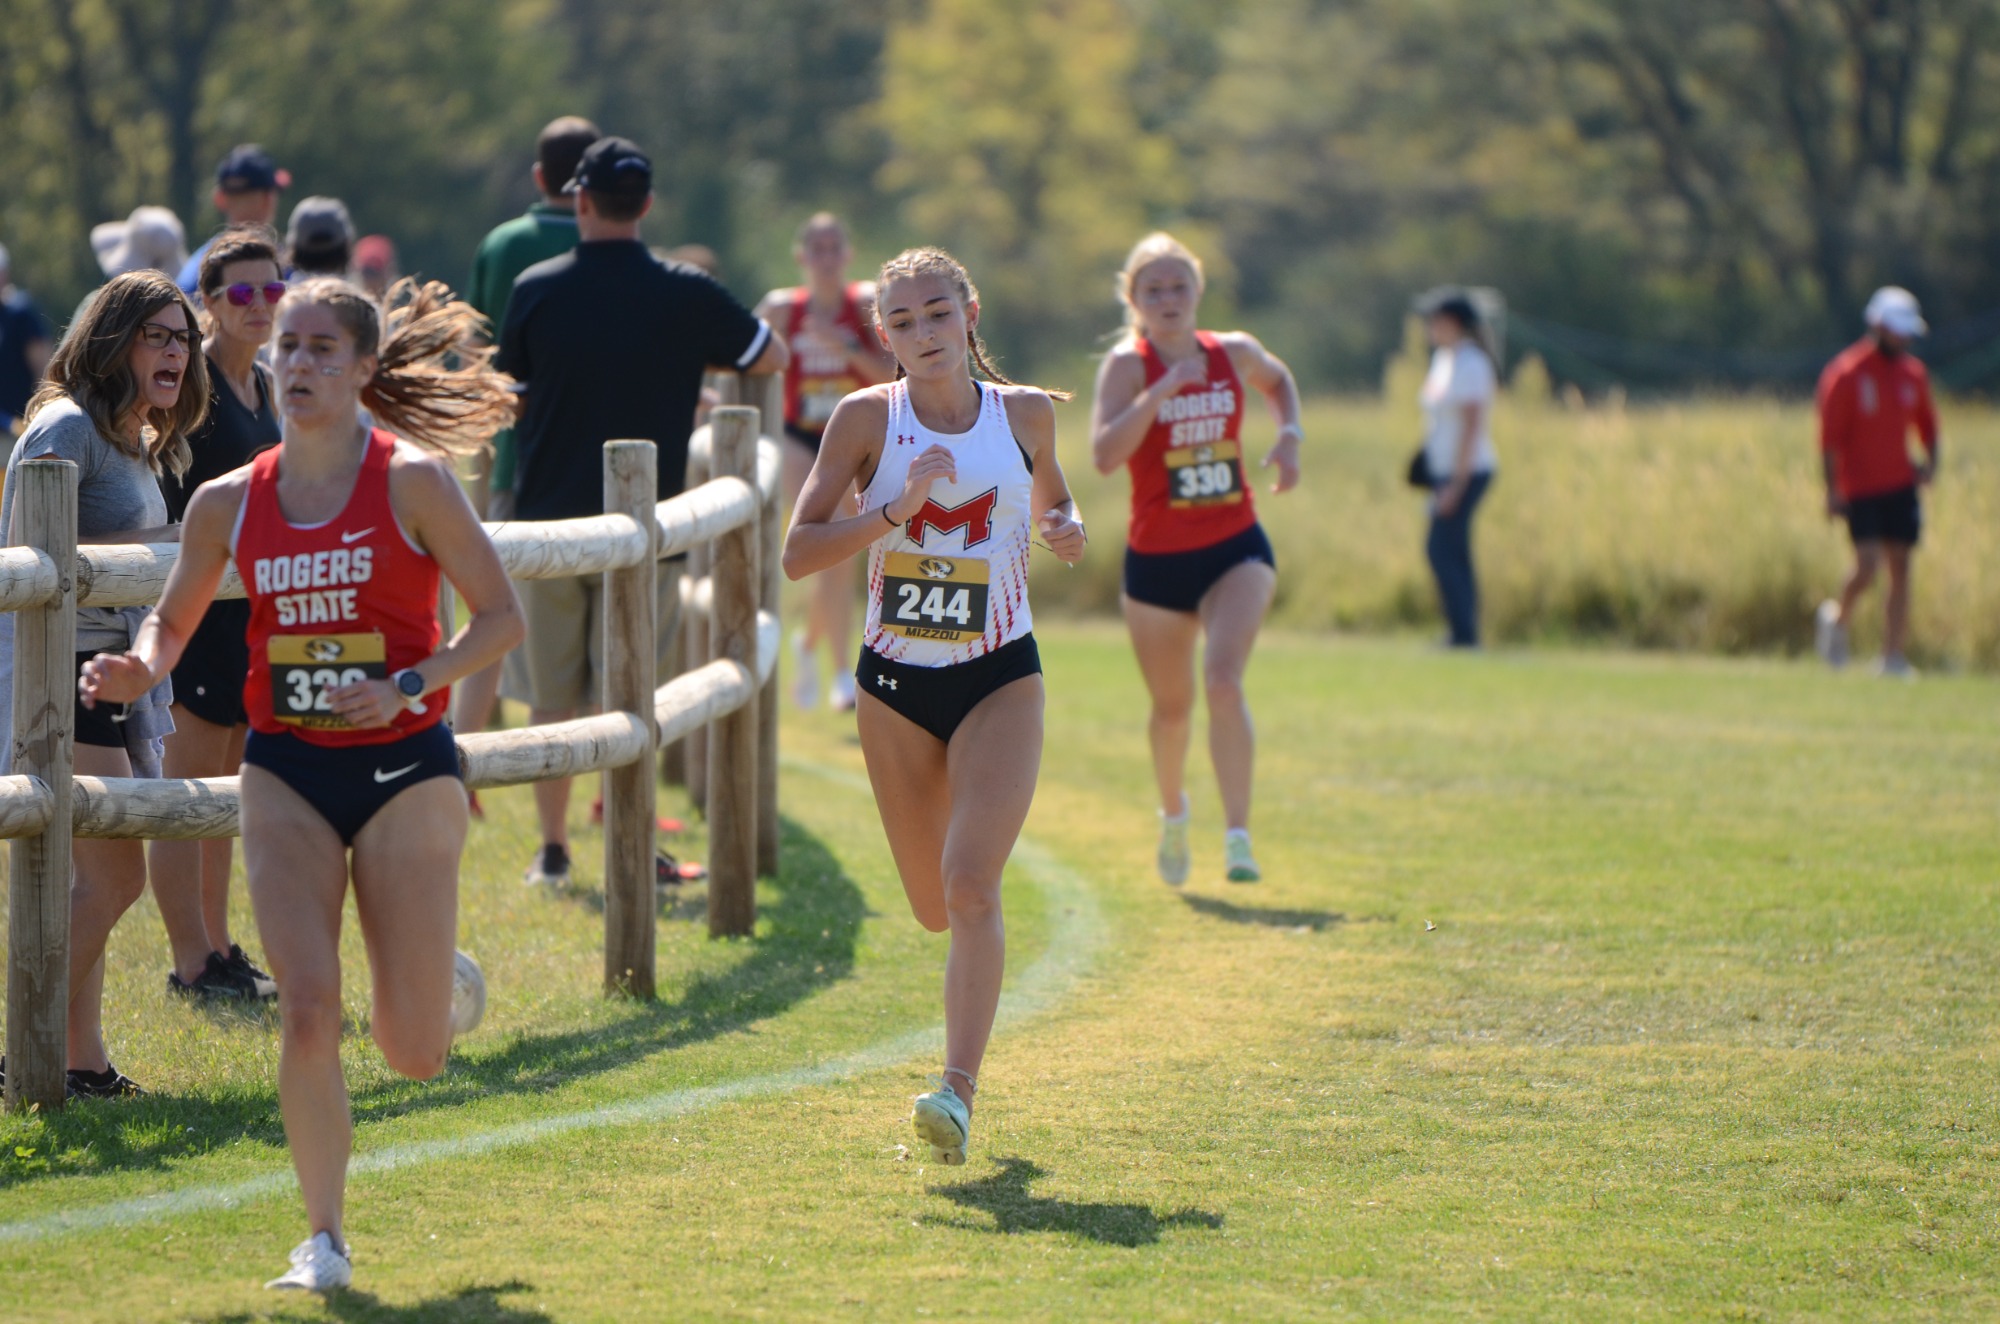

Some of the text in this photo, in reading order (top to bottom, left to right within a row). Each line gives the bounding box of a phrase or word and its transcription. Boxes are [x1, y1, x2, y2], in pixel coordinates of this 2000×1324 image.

[1158, 389, 1235, 424] ROGERS
[1170, 417, 1227, 447] STATE
[1178, 461, 1232, 497] 330
[905, 485, 998, 551] M
[254, 546, 373, 595] ROGERS
[275, 588, 359, 626] STATE
[896, 583, 972, 625] 244
[904, 627, 960, 641] MIZZOU
